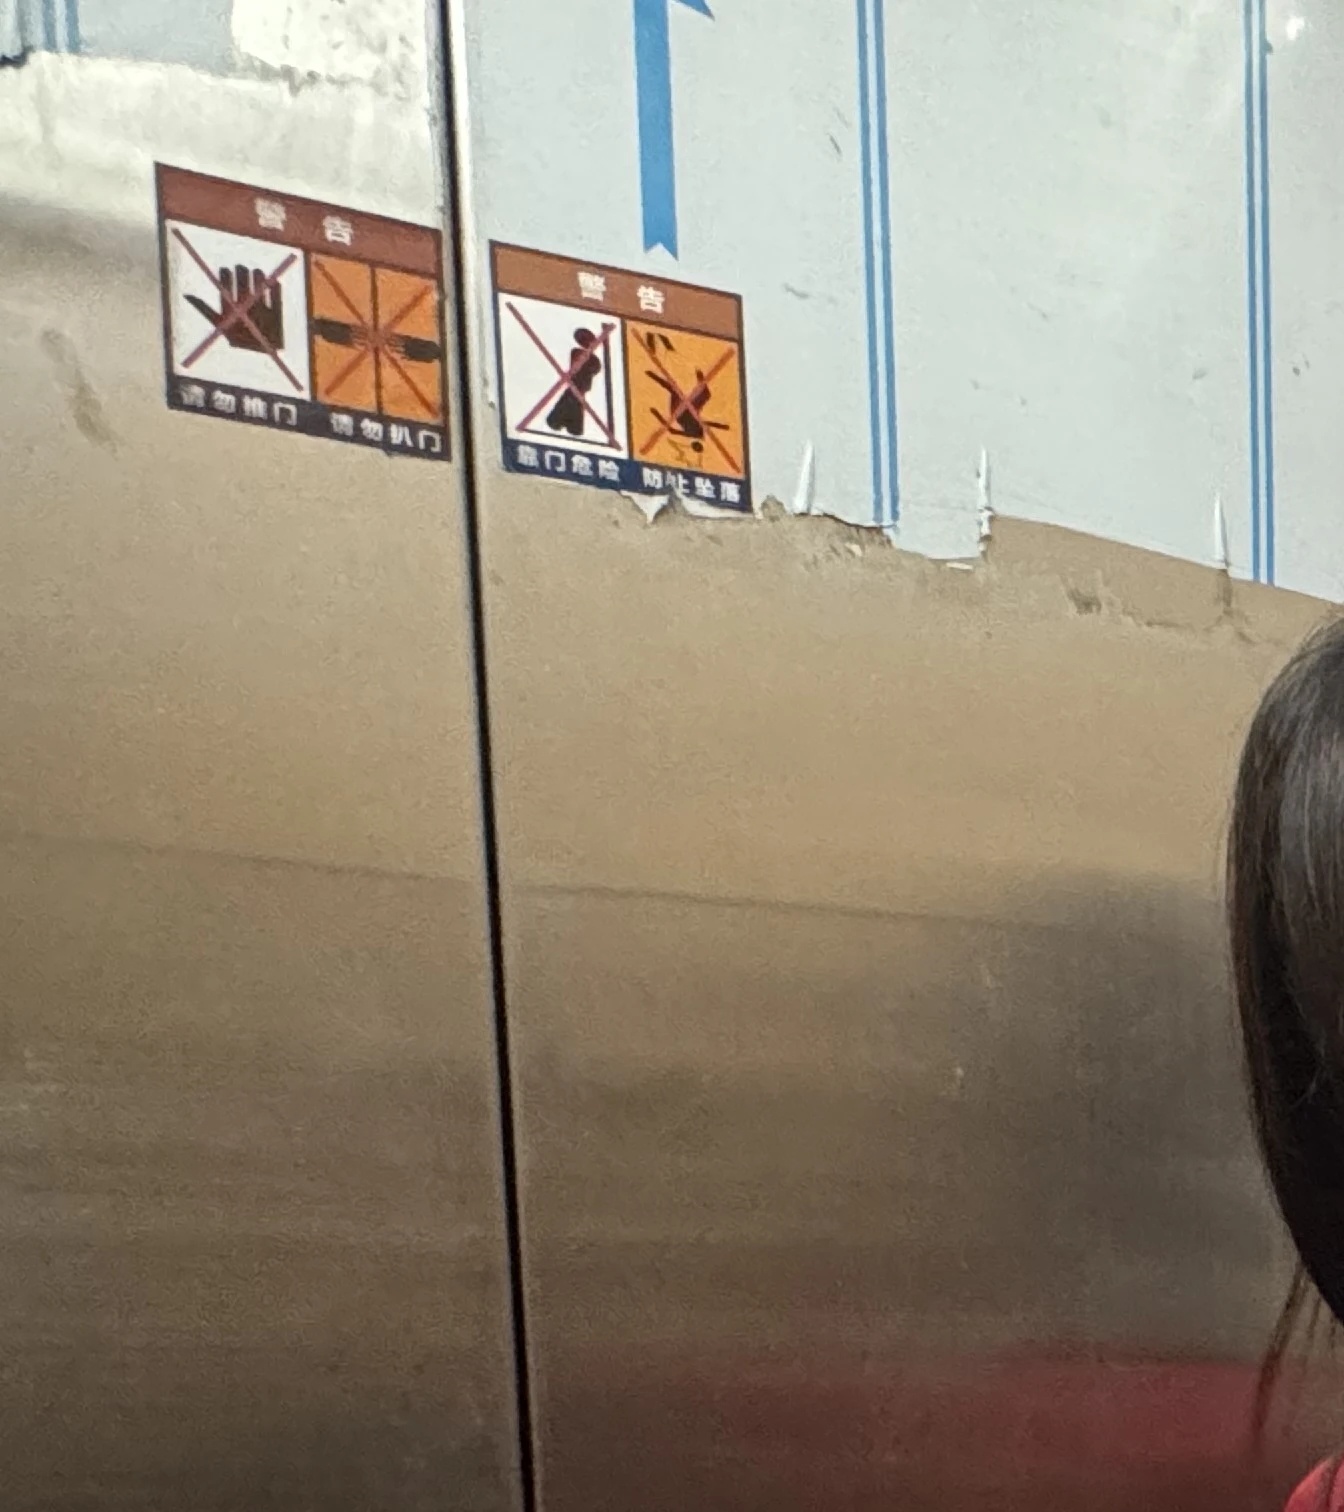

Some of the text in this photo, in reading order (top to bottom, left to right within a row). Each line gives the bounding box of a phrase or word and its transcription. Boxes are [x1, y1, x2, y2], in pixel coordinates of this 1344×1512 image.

[254, 197, 355, 247] 警告
[576, 271, 666, 316] 警告
[179, 383, 444, 454] 请勿推门 请勿扒门
[516, 443, 742, 504] 靠门危险 防止坠落
